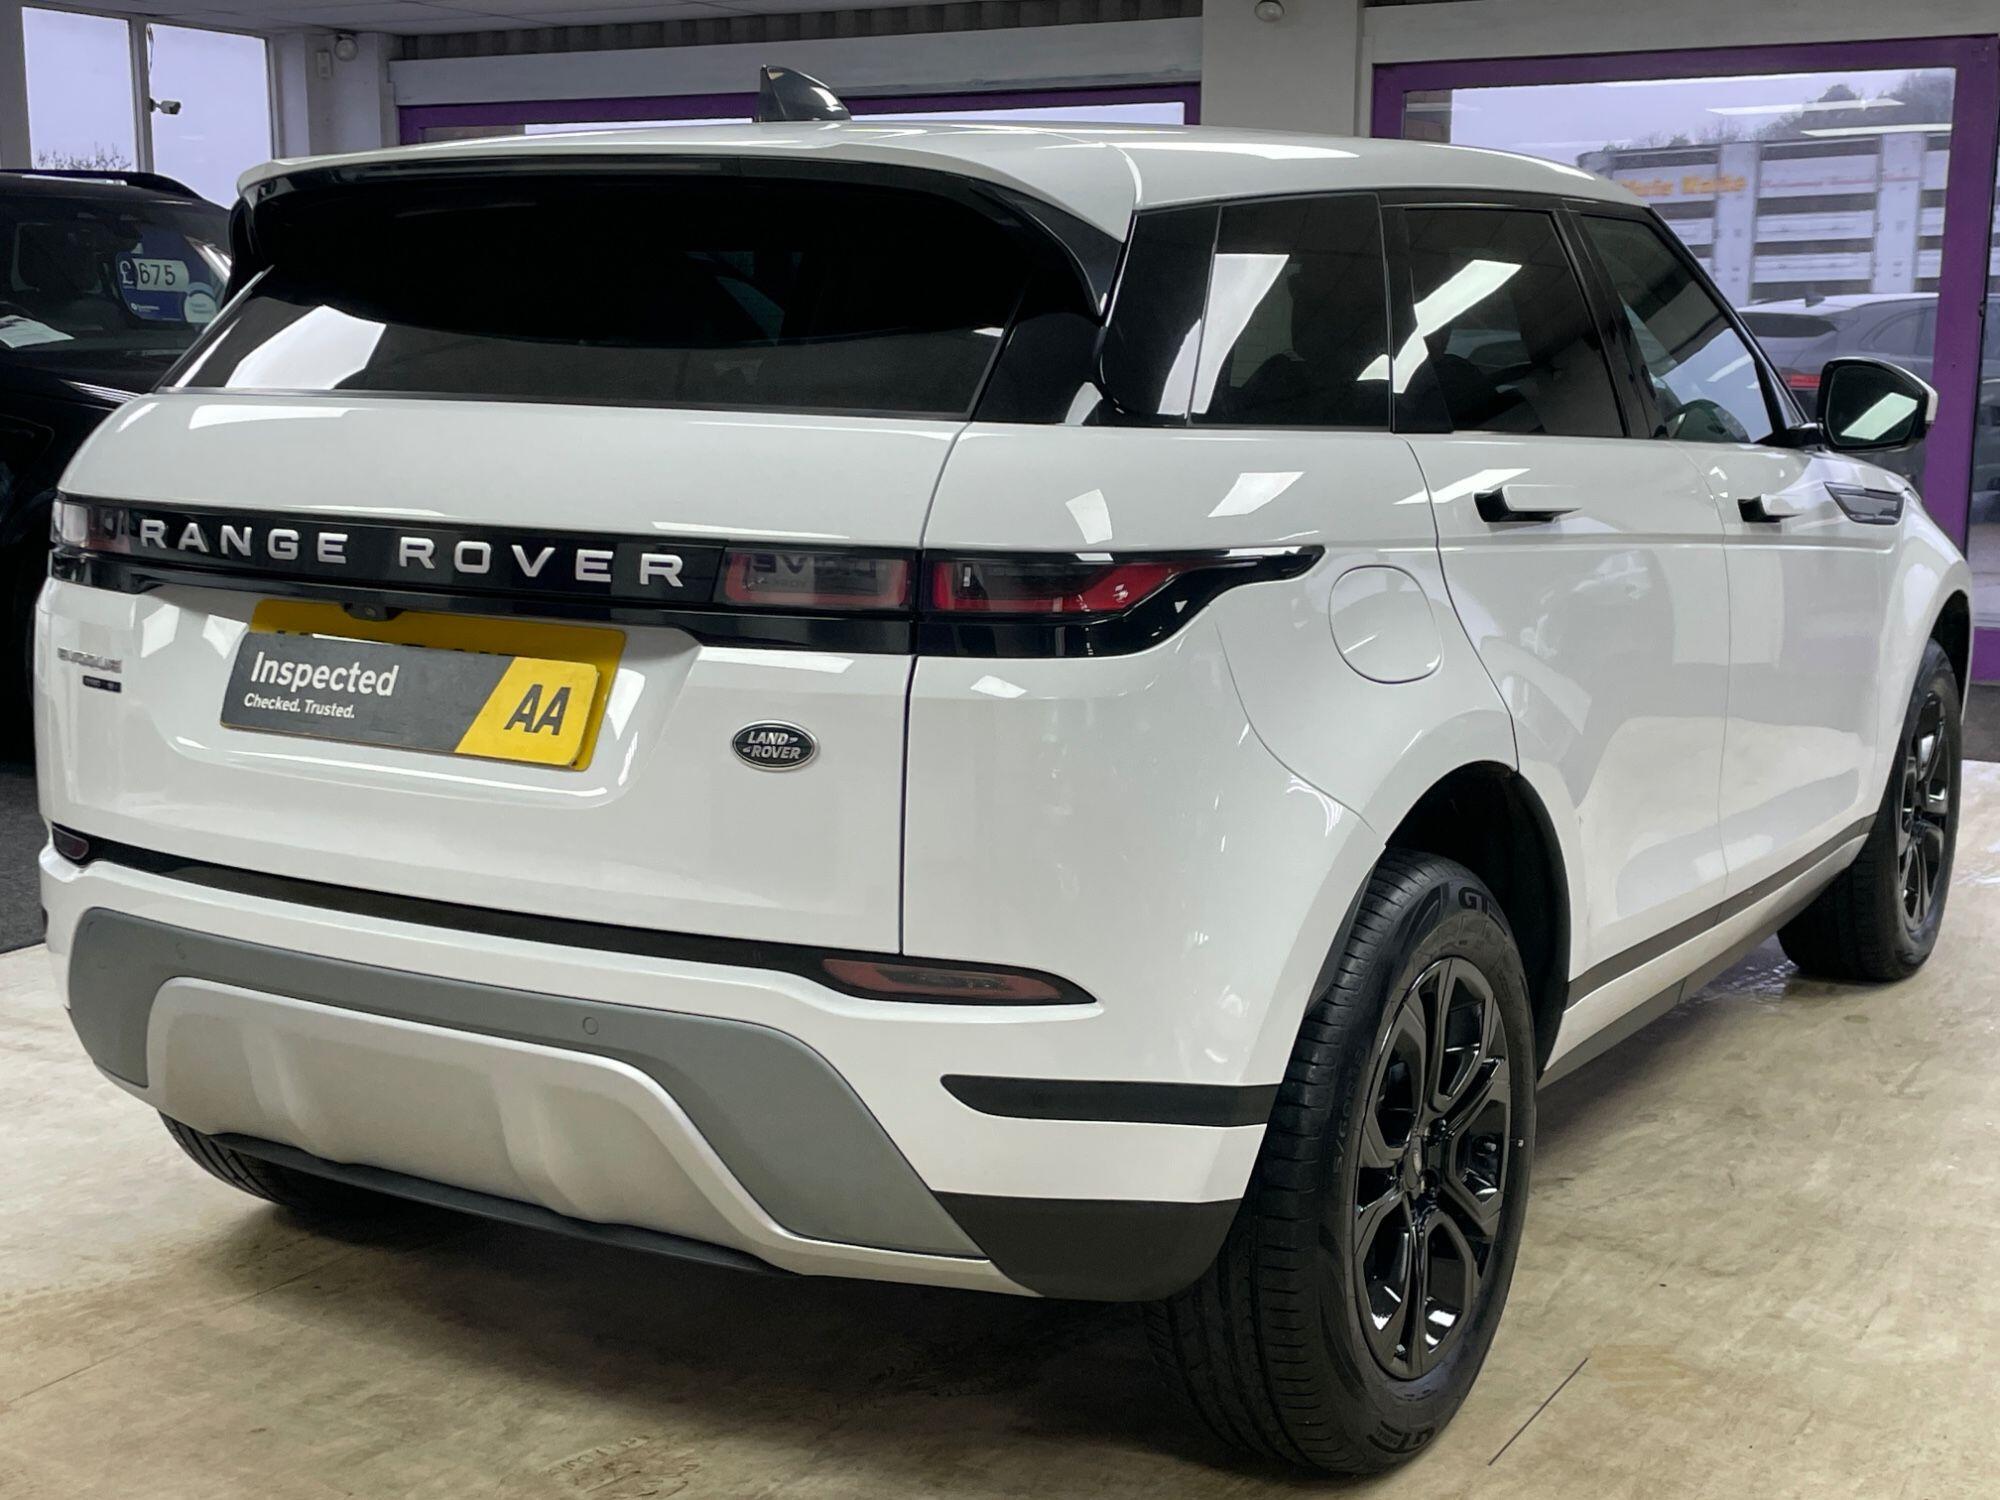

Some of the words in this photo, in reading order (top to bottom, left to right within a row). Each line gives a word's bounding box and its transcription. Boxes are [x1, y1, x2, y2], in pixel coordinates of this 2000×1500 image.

[140, 518, 349, 565] RANGE
[399, 536, 685, 588] ROVER
[250, 651, 399, 697] Inspected
[244, 693, 301, 713] Checked.
[304, 699, 355, 720] Trusted.
[503, 683, 572, 737] AA
[747, 731, 789, 746] LAND
[750, 744, 801, 759] ROVER
